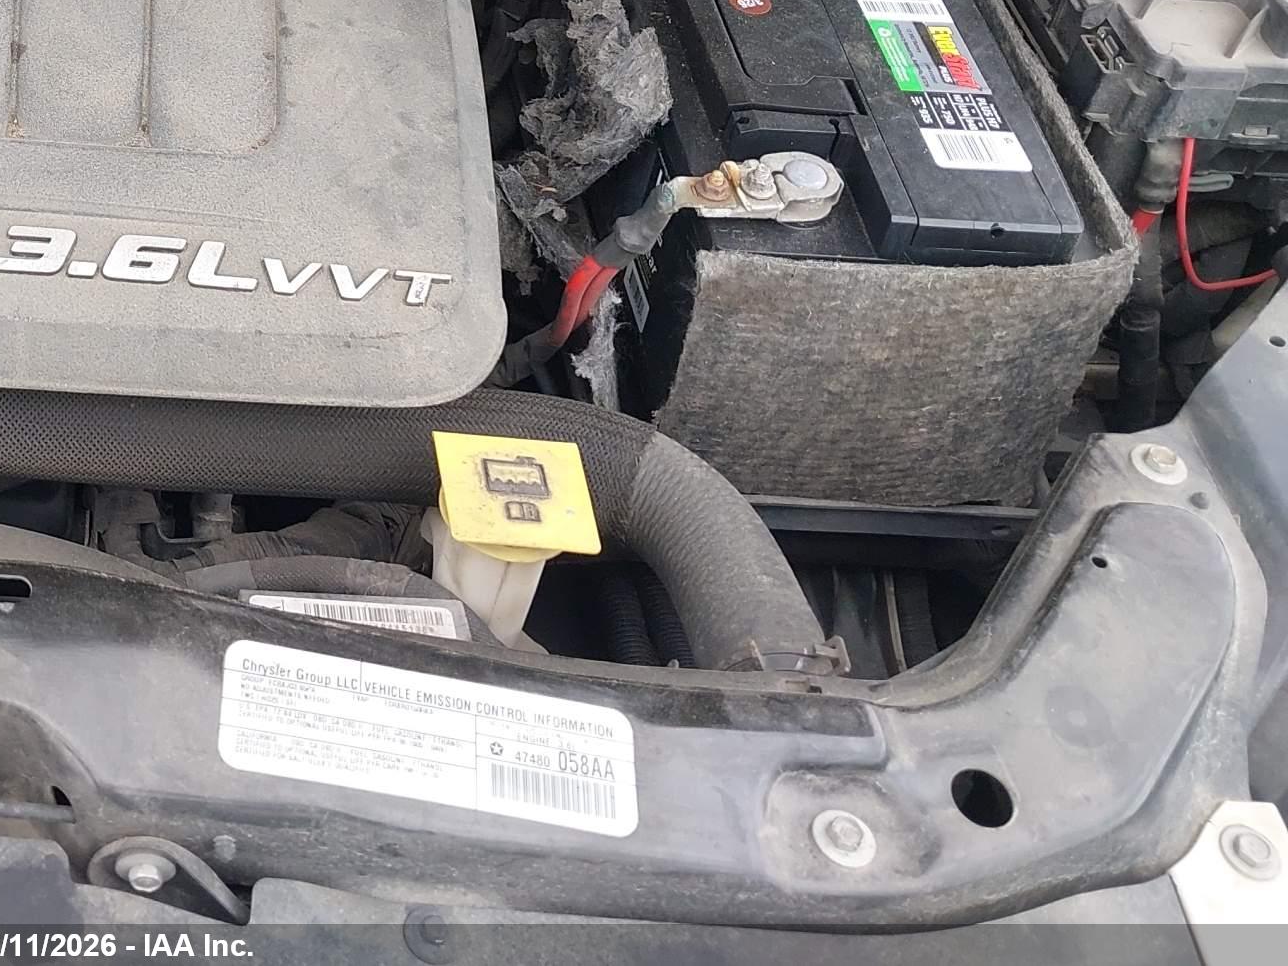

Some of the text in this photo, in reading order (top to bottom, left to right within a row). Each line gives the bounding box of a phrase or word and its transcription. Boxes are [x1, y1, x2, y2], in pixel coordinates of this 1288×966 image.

[976, 97, 993, 117] PLUS
[986, 117, 1000, 129] H7
[242, 658, 291, 677] Chrysler
[296, 668, 331, 687] Group
[337, 675, 358, 690] LLC
[364, 681, 410, 700] VEHICLE
[416, 690, 471, 711] EMISSION
[476, 701, 528, 722] CONTROL
[534, 713, 613, 738] INFORMATION
[558, 751, 615, 780] 058AA
